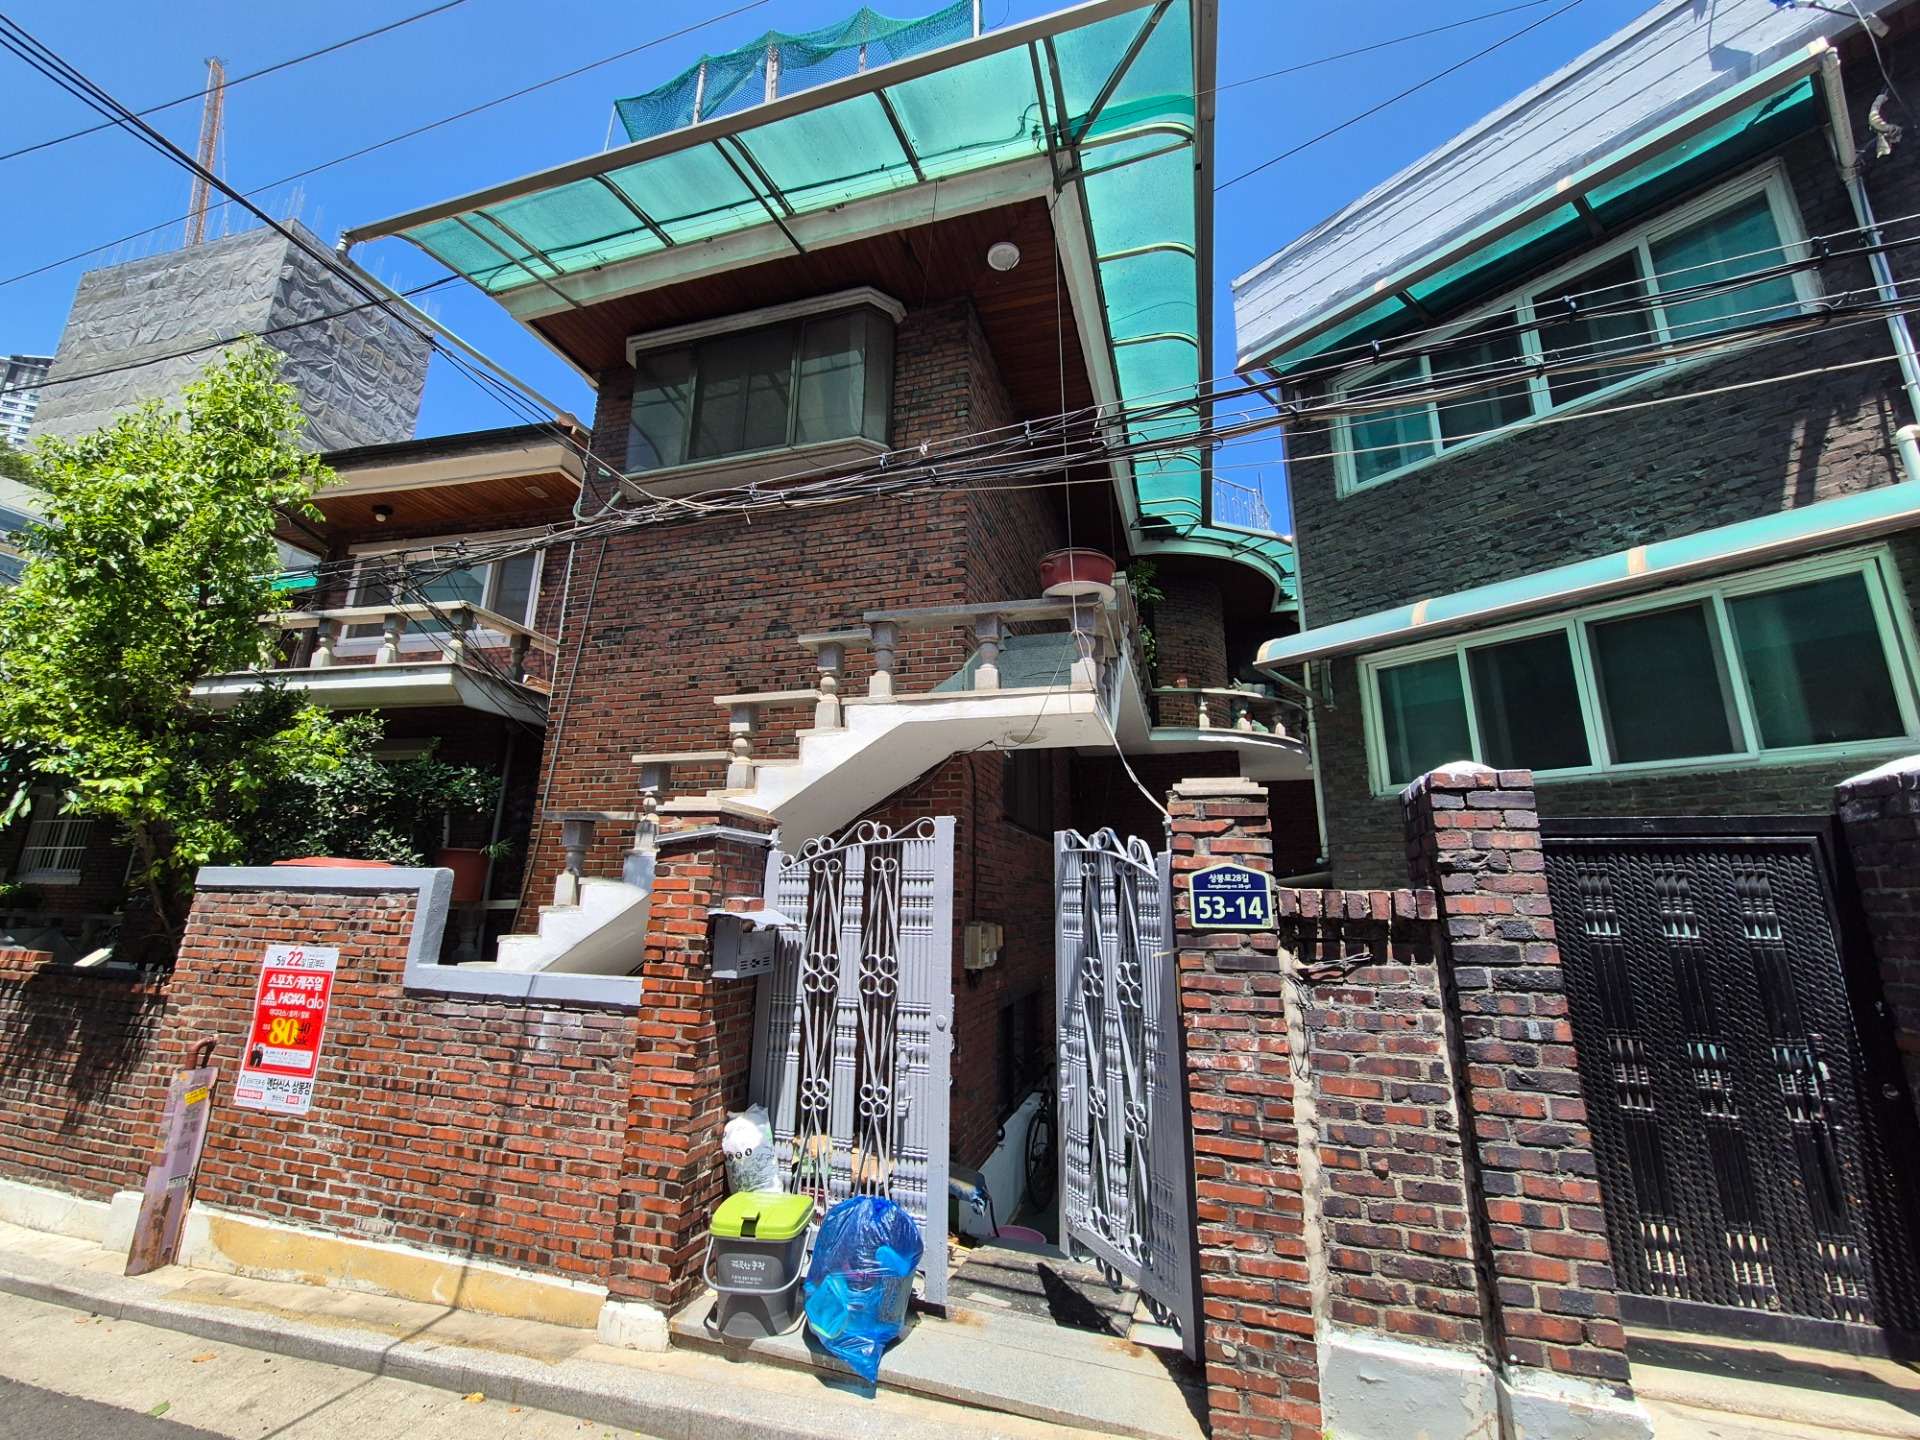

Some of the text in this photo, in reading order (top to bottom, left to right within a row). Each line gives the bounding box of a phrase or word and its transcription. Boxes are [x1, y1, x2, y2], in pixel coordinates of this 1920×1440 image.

[1209, 874, 1249, 883] 상봉로28길
[1199, 896, 1264, 919] 53-14
[286, 951, 307, 967] 22일
[268, 974, 324, 991] 스포츠/캐주얼
[278, 992, 306, 1006] HOKA
[306, 992, 324, 1009] alo
[267, 1078, 290, 1092] 엔터식스
[292, 1081, 312, 1095] 상봉점
